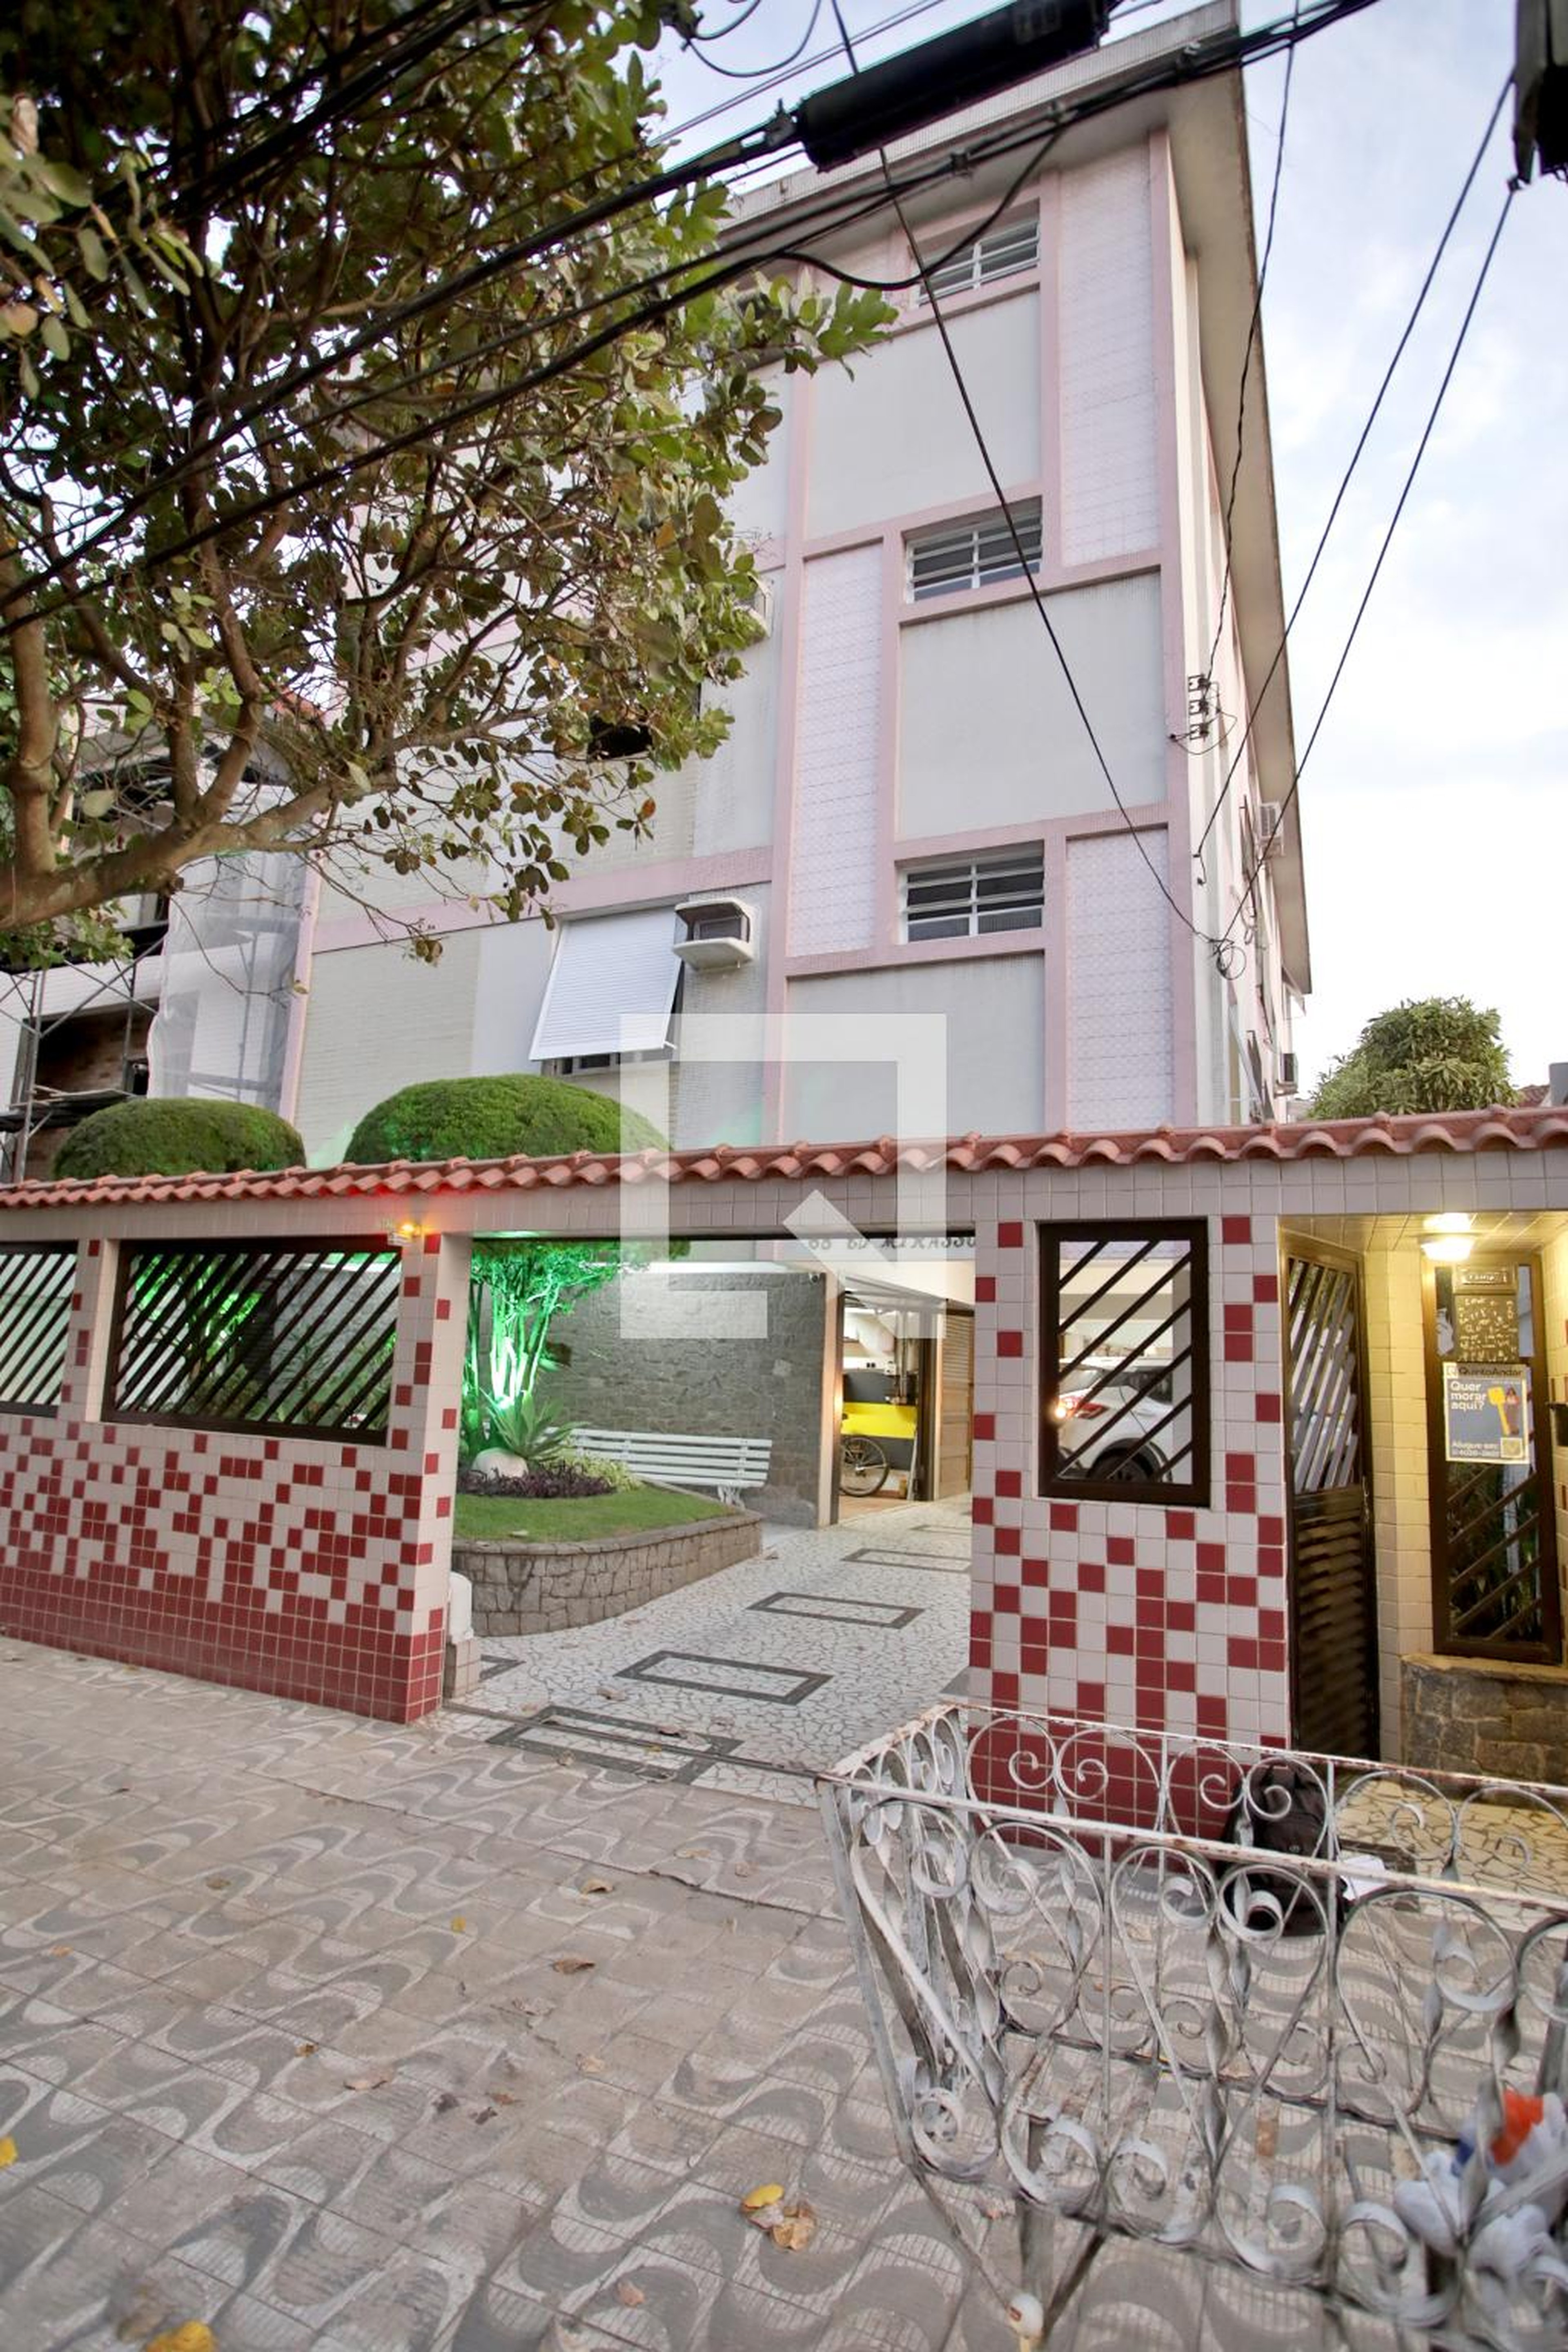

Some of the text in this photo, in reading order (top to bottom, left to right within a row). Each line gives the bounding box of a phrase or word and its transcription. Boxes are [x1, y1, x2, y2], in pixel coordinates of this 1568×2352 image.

[1450, 1381, 1481, 1391] Quer
[1450, 1392, 1487, 1401] morar
[1451, 1401, 1484, 1413] aqui?
